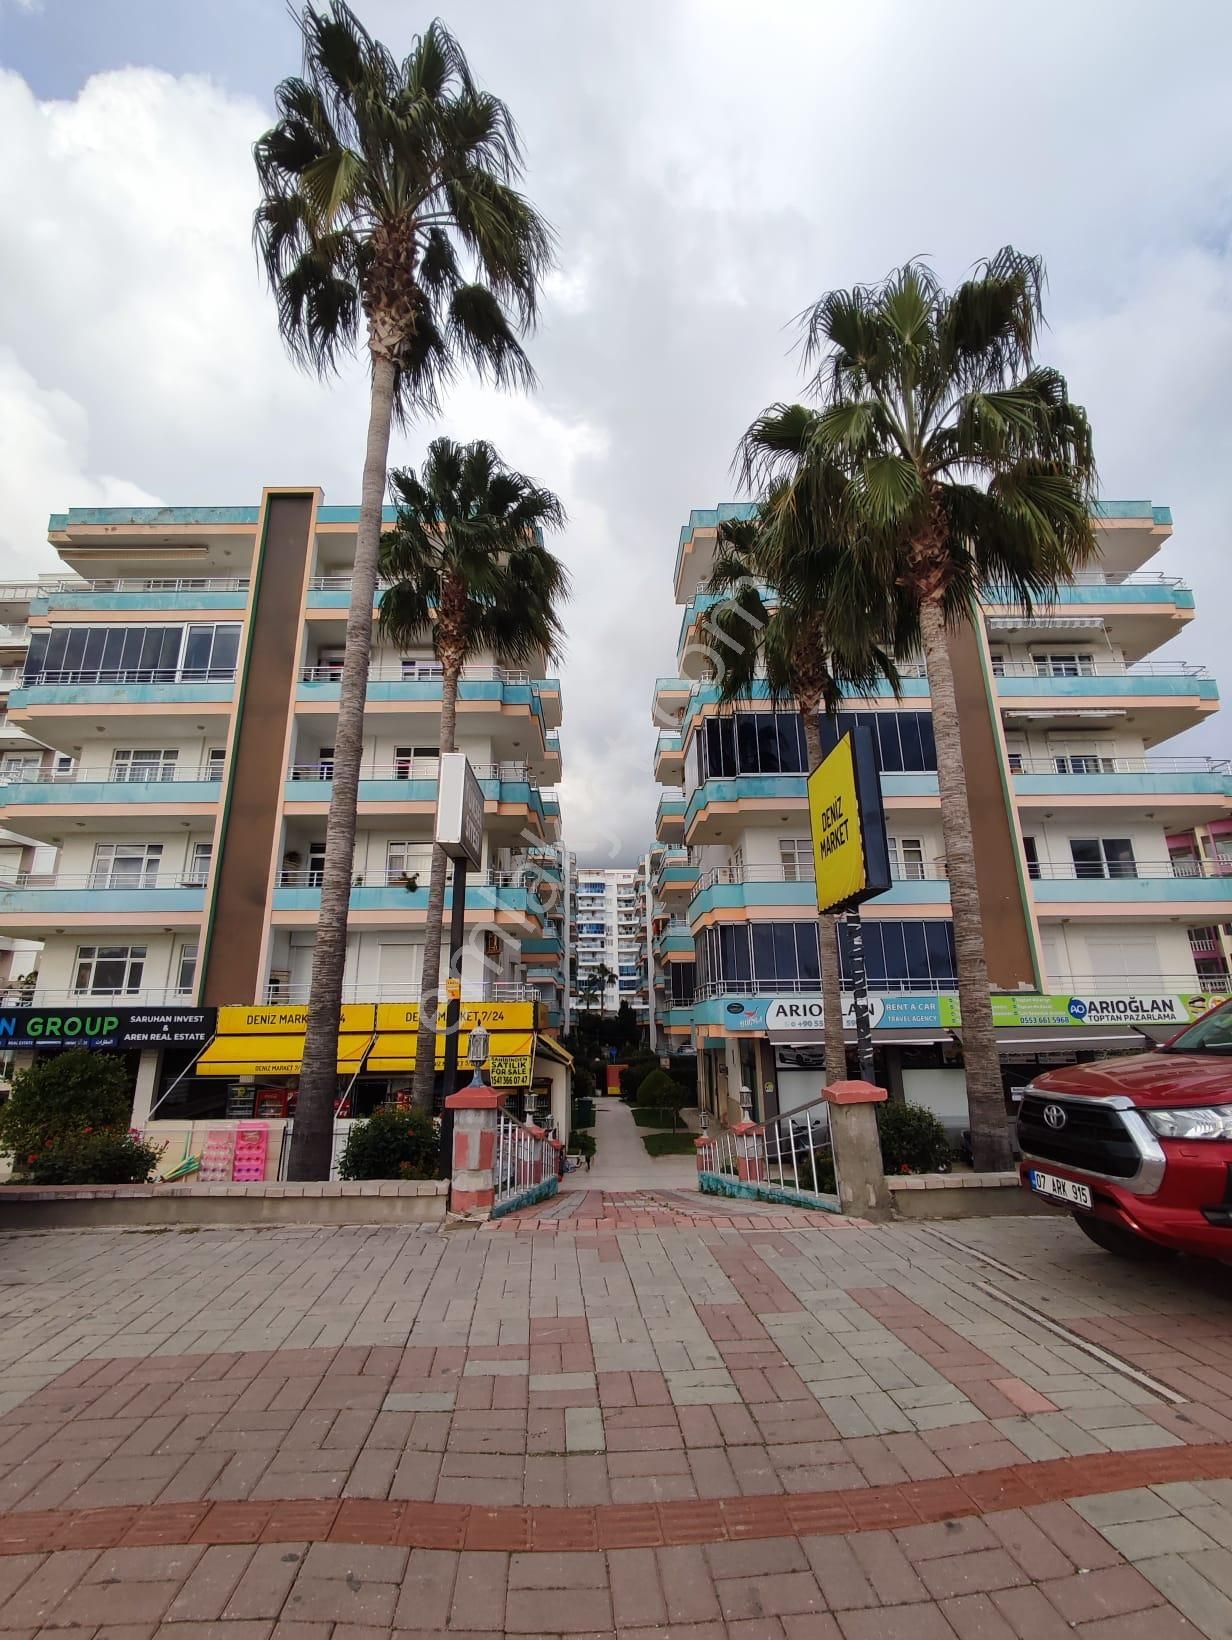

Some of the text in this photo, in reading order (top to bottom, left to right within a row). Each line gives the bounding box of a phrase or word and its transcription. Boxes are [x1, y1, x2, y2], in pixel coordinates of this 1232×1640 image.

[820, 818, 849, 861] MARKET
[918, 1003, 936, 1011] CAR
[1088, 997, 1174, 1013] ARIOĞLAN
[130, 1015, 205, 1023] SARUHAN INVEST
[279, 1013, 309, 1025] MARK
[481, 1012, 504, 1022] 7/24
[1088, 1013, 1177, 1023] TOPTAN PAZARLAMA
[26, 1016, 119, 1037] GROUP
[124, 1033, 206, 1041] AREN REAL ESTATE
[491, 1061, 526, 1069] SATILIK
[1036, 1173, 1088, 1203] 07 ARK 915
